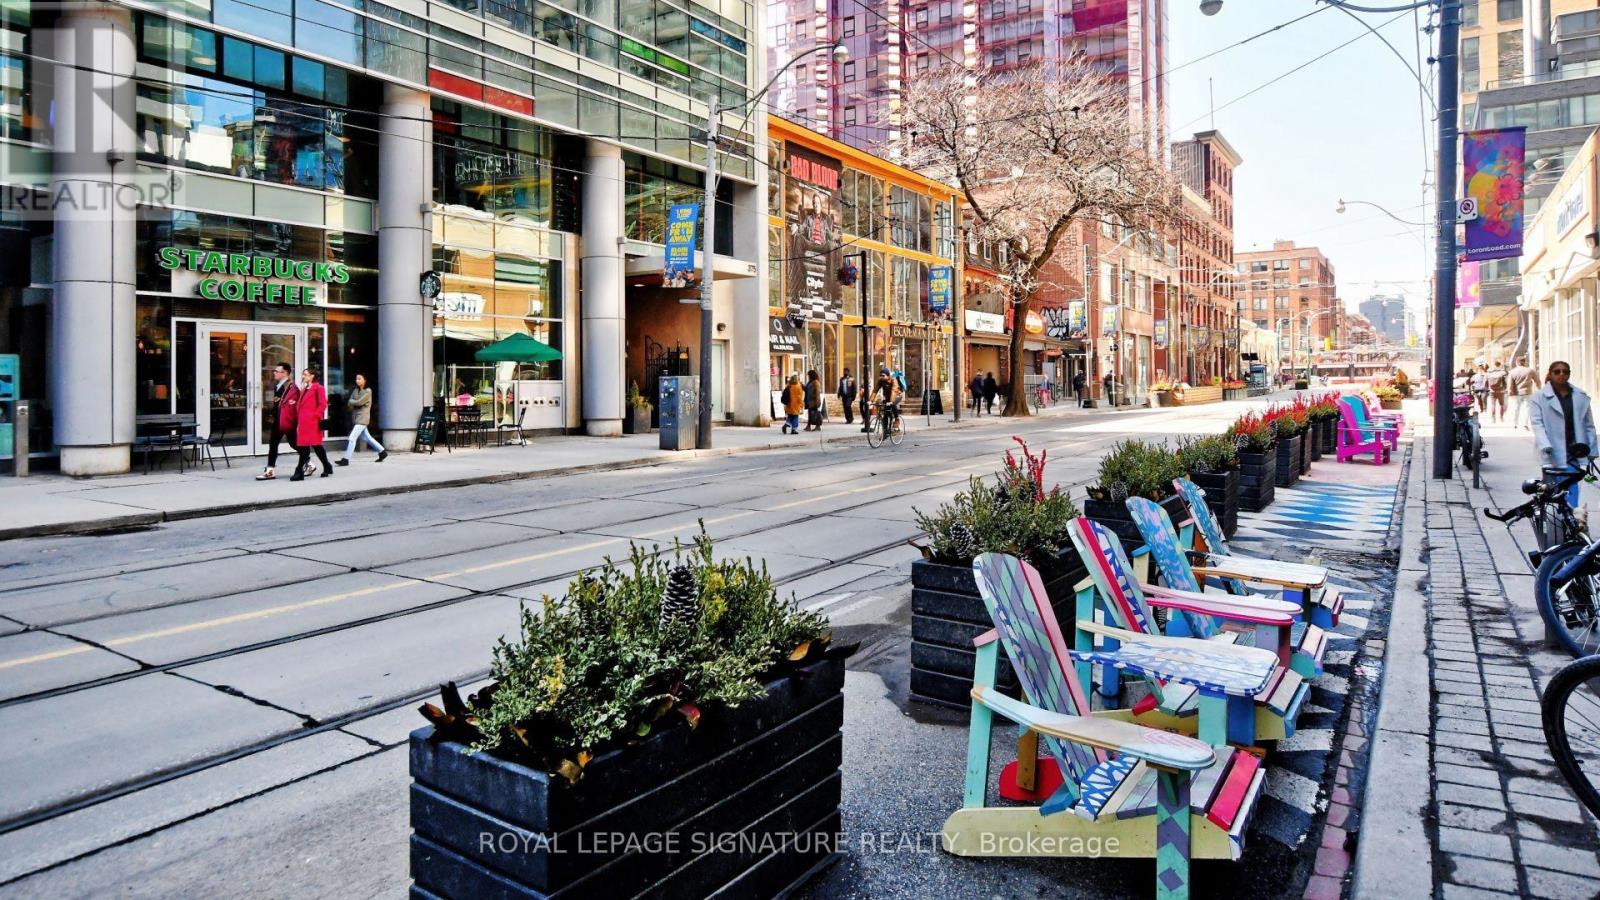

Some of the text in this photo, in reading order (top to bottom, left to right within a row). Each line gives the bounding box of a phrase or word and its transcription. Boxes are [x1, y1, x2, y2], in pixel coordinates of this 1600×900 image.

[790, 154, 810, 182] BAD
[160, 247, 350, 283] STARBUCKS
[200, 278, 317, 306] COFFEE
[768, 334, 779, 344] AIR
[785, 335, 800, 345] NAIL
[773, 318, 784, 333] Q
